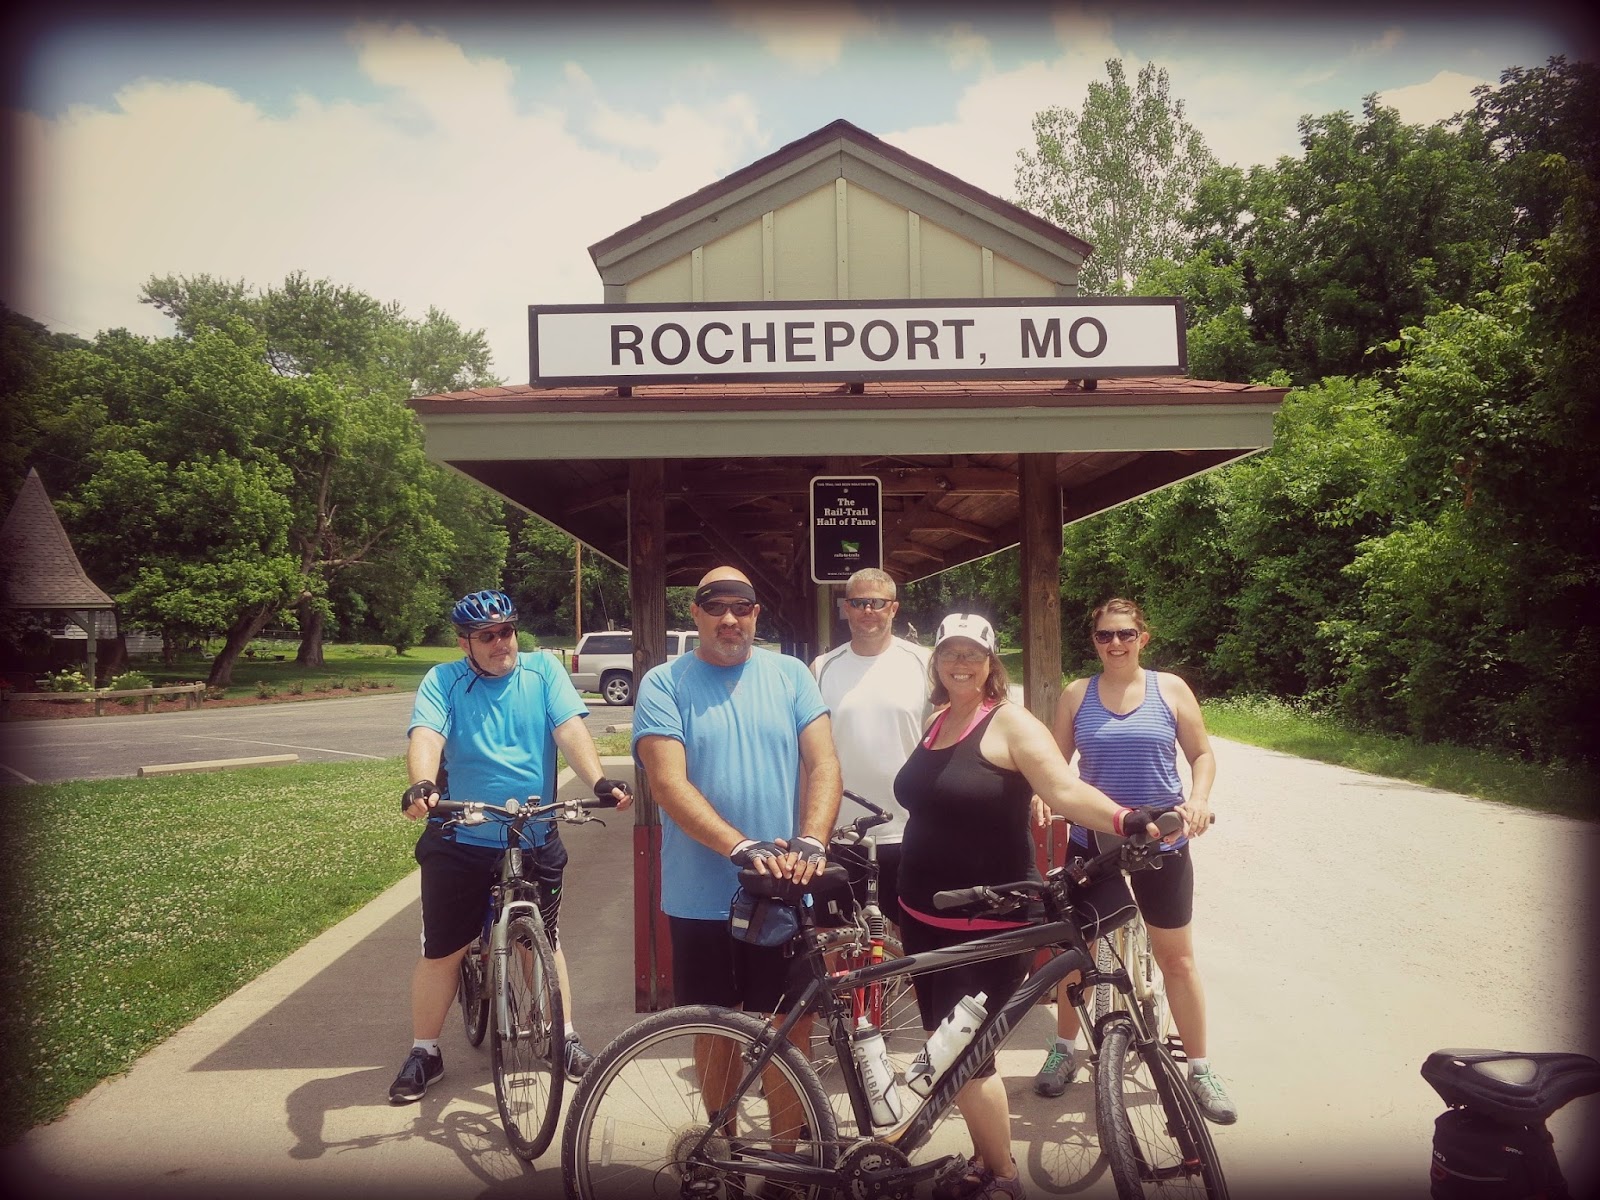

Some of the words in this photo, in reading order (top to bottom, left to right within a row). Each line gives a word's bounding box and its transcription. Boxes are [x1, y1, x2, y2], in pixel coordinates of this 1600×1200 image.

[610, 318, 987, 366] ROCHEPORT,
[1020, 316, 1109, 359] MO
[824, 507, 869, 516] Rail-Trail
[837, 498, 855, 506] The
[816, 518, 837, 526] Hall
[839, 518, 849, 526] of
[851, 518, 877, 526] Fame
[856, 1046, 884, 1106] CAMELBAK
[916, 1012, 1010, 1134] SPECIALIZED
